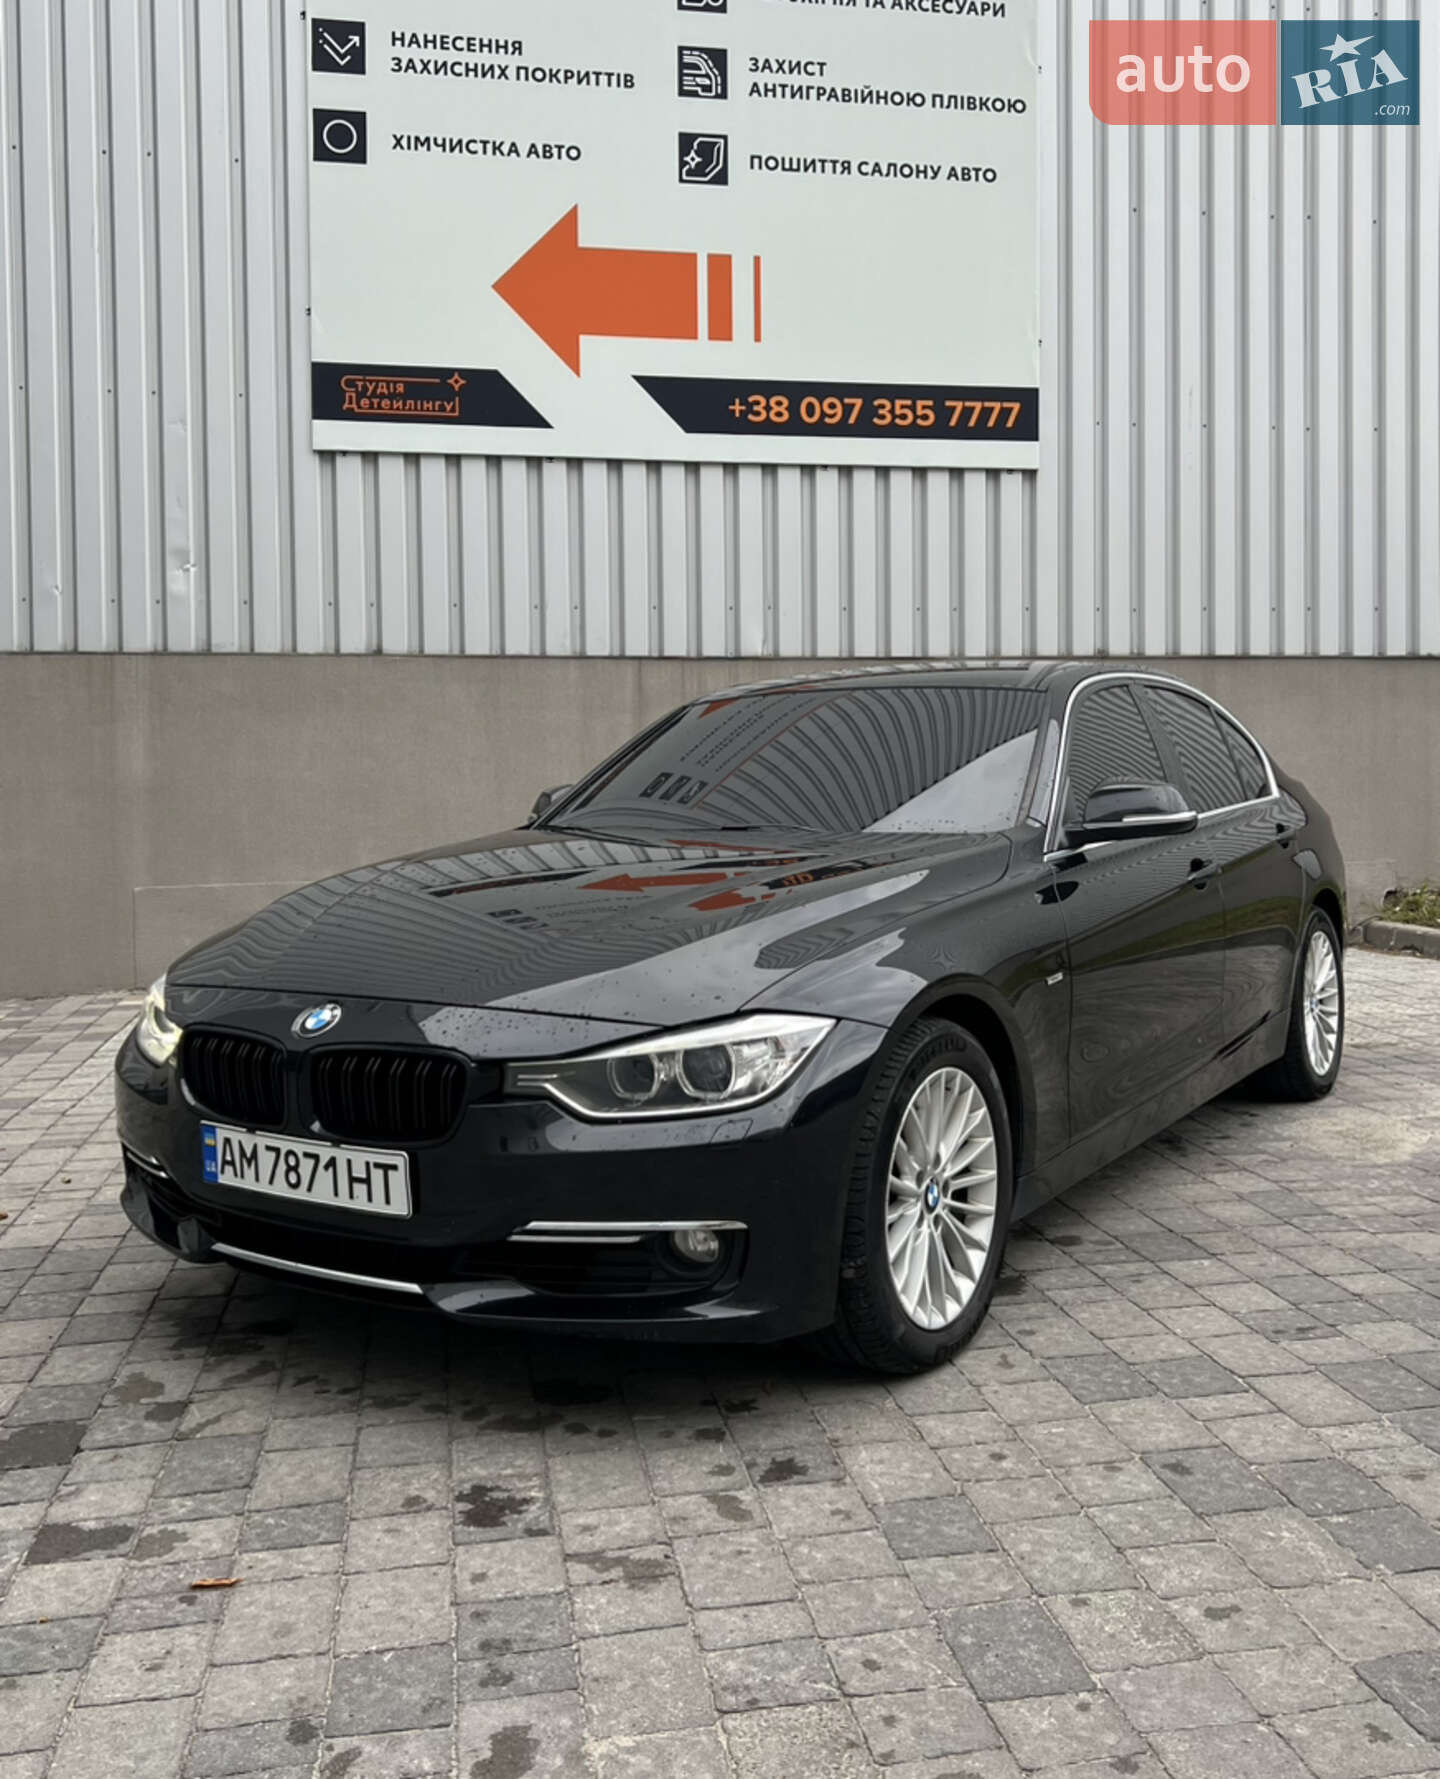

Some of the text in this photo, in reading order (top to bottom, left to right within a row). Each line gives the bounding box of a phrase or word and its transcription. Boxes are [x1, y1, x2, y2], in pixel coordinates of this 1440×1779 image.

[890, 0, 1006, 18] АКСЕСУАРИ
[390, 31, 523, 56] НАНЕСЕННЯ
[390, 57, 636, 89] ЗАХИСНИХ ПОКРИТТІВ
[749, 57, 827, 77] ЗАХИСТ
[749, 81, 1027, 114] АНТИГРАВІЙНОЮ ПЛІВКОЮ
[391, 134, 582, 161] ХІМЧИСТКА АВТО
[750, 154, 998, 184] ПОШИТТЯ САЛОНУ АВТО
[340, 375, 405, 396] Студія
[728, 395, 1021, 428] +38 097 355 7777
